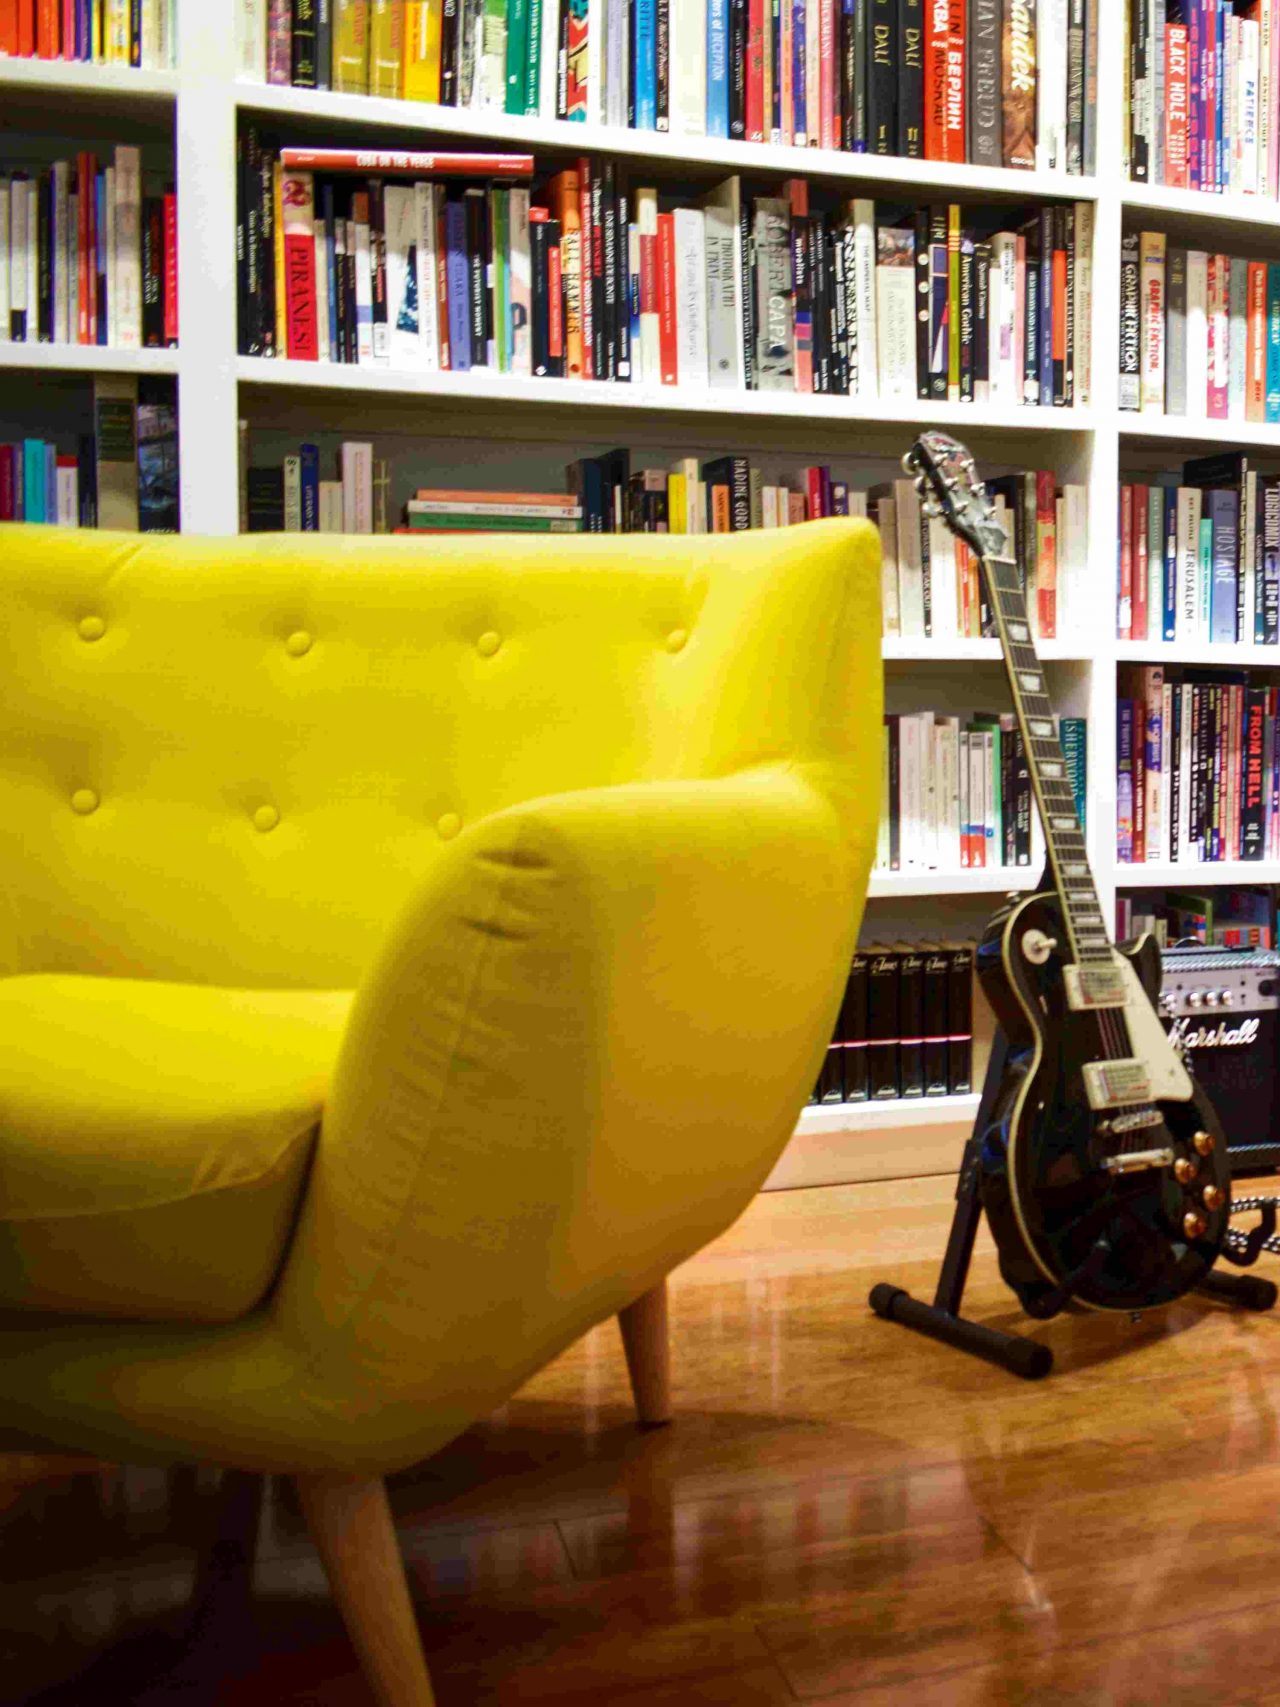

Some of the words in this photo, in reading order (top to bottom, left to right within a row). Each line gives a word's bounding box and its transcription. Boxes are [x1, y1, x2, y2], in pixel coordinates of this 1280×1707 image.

[711, 32, 725, 81] DECEPTION
[874, 25, 892, 66] DALÍ
[905, 28, 922, 69] DALÍ
[1169, 28, 1187, 76] BLACK
[933, 50, 947, 127] MOSKAU
[947, 50, 962, 131] БЕРЛИН
[976, 47, 996, 129] FREUD
[1069, 100, 1084, 124] GIRL
[1169, 81, 1187, 123] HOLE
[1244, 80, 1256, 146] PATIENCE
[393, 154, 408, 169] THE
[707, 236, 721, 247] IN
[767, 215, 787, 293] ROBERT
[794, 237, 806, 286] muralists
[473, 268, 482, 305] FUTURIST
[707, 251, 721, 282] PRINT
[721, 237, 736, 308] PHOTOGRAPHY
[960, 255, 974, 306] American
[977, 262, 988, 290] Spanish
[1255, 269, 1265, 287] The
[290, 247, 311, 352] PIRANESI
[567, 273, 582, 335] HAMMER
[864, 295, 873, 313] MAP
[977, 291, 988, 320] Cinema
[1124, 264, 1139, 319] GRAPHIC
[1149, 279, 1162, 325] GRAPHIC
[474, 306, 483, 338] MOMENT
[768, 296, 787, 350] CAPA
[961, 308, 974, 345] Gothic
[1123, 320, 1139, 373] FICTION
[1271, 300, 1280, 346] AMERICAN
[733, 459, 750, 499] NADINE
[1264, 488, 1280, 549] LOGICOMIX
[1215, 525, 1236, 586] HOSTAGE
[1184, 544, 1198, 621] JERUSALEM
[1247, 705, 1264, 756] FROM
[1064, 719, 1079, 798] ISHERWOOD
[1246, 758, 1263, 809] HELL
